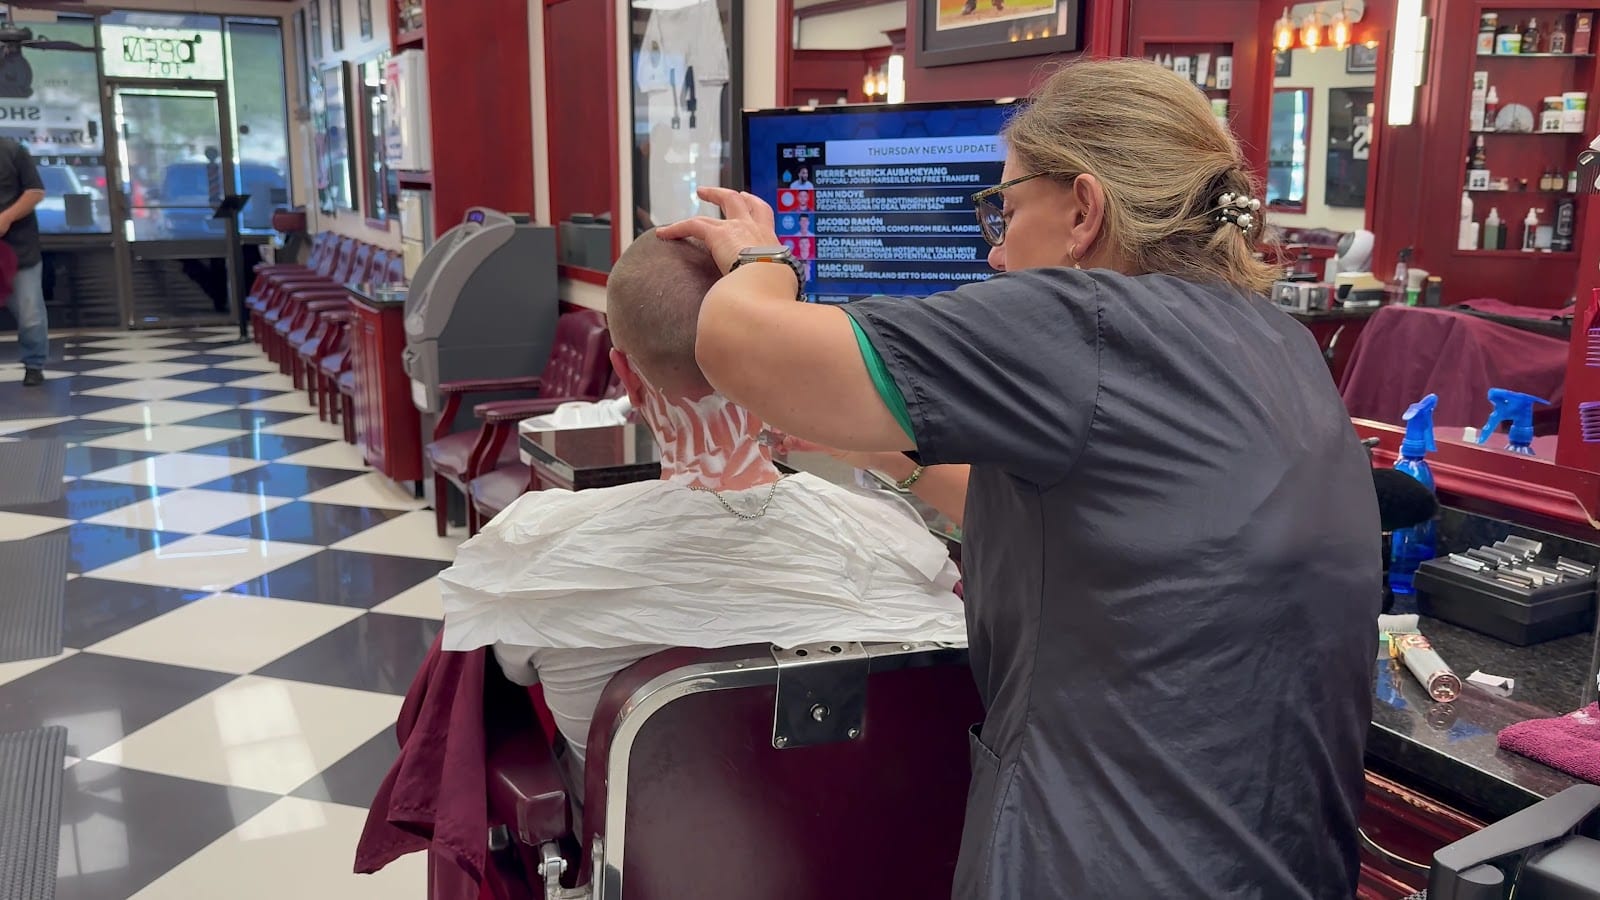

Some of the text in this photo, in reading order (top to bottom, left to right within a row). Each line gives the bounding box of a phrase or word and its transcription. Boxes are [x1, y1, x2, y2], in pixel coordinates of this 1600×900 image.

[868, 144, 997, 155] THURSDAY NEWS UPDATE
[816, 190, 864, 198] DAN NDOYE
[816, 216, 883, 226] JACOBO RAMÓN
[841, 239, 883, 247] PALHINHA
[818, 264, 842, 272] MARC
